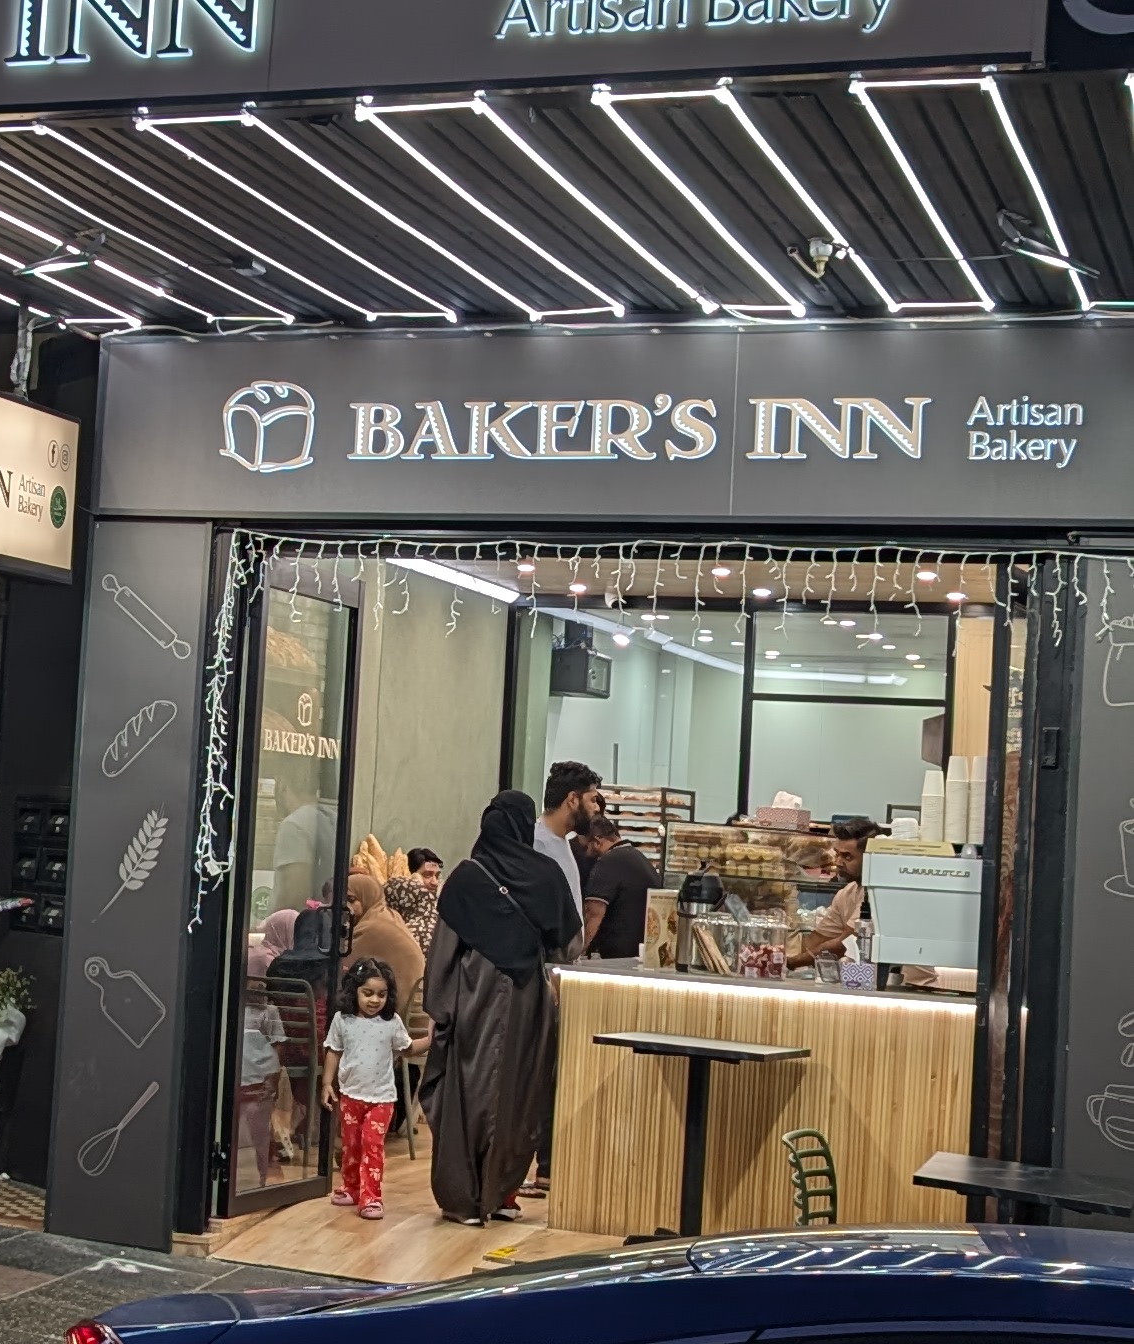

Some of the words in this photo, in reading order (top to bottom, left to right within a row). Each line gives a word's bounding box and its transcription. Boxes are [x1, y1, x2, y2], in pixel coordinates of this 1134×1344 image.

[966, 395, 1083, 426] Artisan
[346, 393, 718, 463] BAKER'S
[746, 396, 933, 460] INN
[967, 429, 1077, 468] Bakery
[18, 474, 46, 497] Artisan
[17, 495, 44, 522] Bakery
[263, 729, 315, 756] BAKER'S
[317, 737, 340, 760] INN
